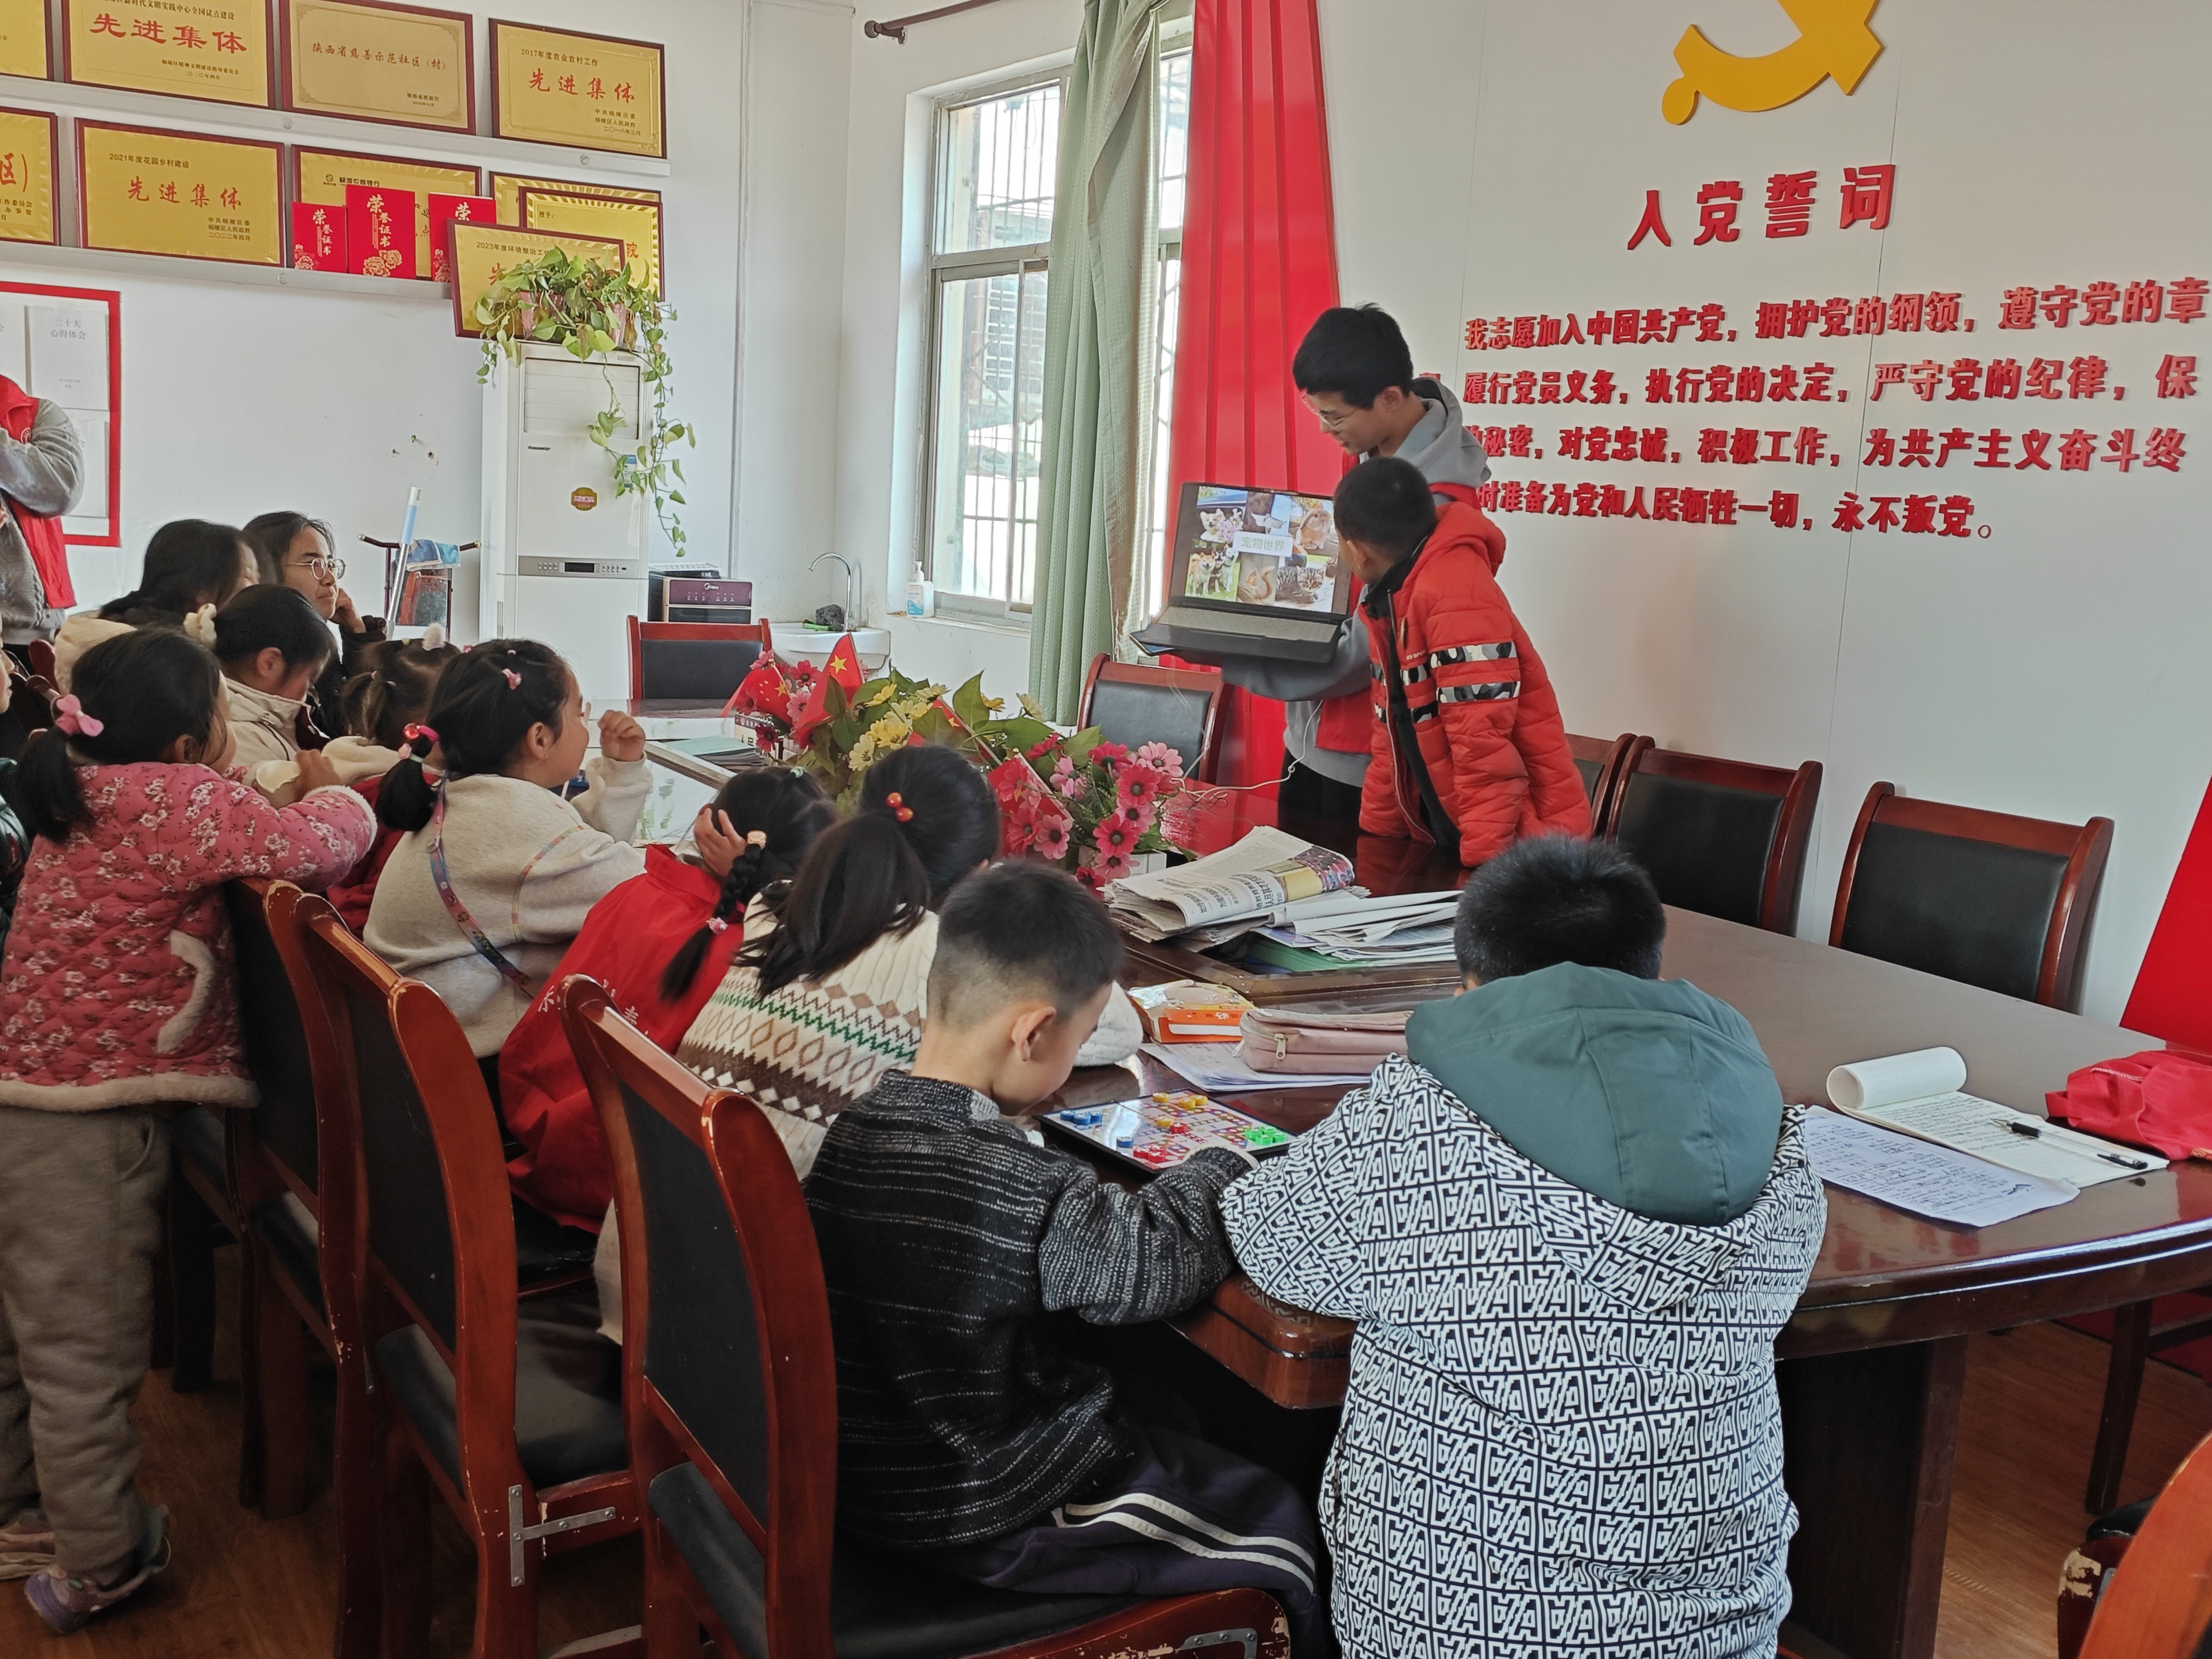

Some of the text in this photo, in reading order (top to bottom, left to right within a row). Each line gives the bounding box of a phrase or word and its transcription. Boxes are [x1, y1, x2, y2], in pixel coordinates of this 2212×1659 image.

[90, 13, 247, 54] 先进集体
[521, 48, 599, 67] 2017年度农业农村工作
[529, 68, 635, 104] 先进集体
[595, 109, 636, 119] 中共杨陵区委
[595, 117, 636, 128] 杨陵区人民政府
[110, 153, 189, 168] 2021年度花园乡村建设
[127, 176, 241, 210] 先进集体
[367, 193, 393, 247] 荣誉证书
[455, 201, 471, 221] 荣
[208, 217, 250, 226] 中共杨陵区委
[208, 224, 250, 234] 杨陵区人民政府
[1419, 354, 2198, 404] 履行党员义务，执行党的决定，严守党的纪律，保
[1241, 537, 1285, 551] 宠物世界
